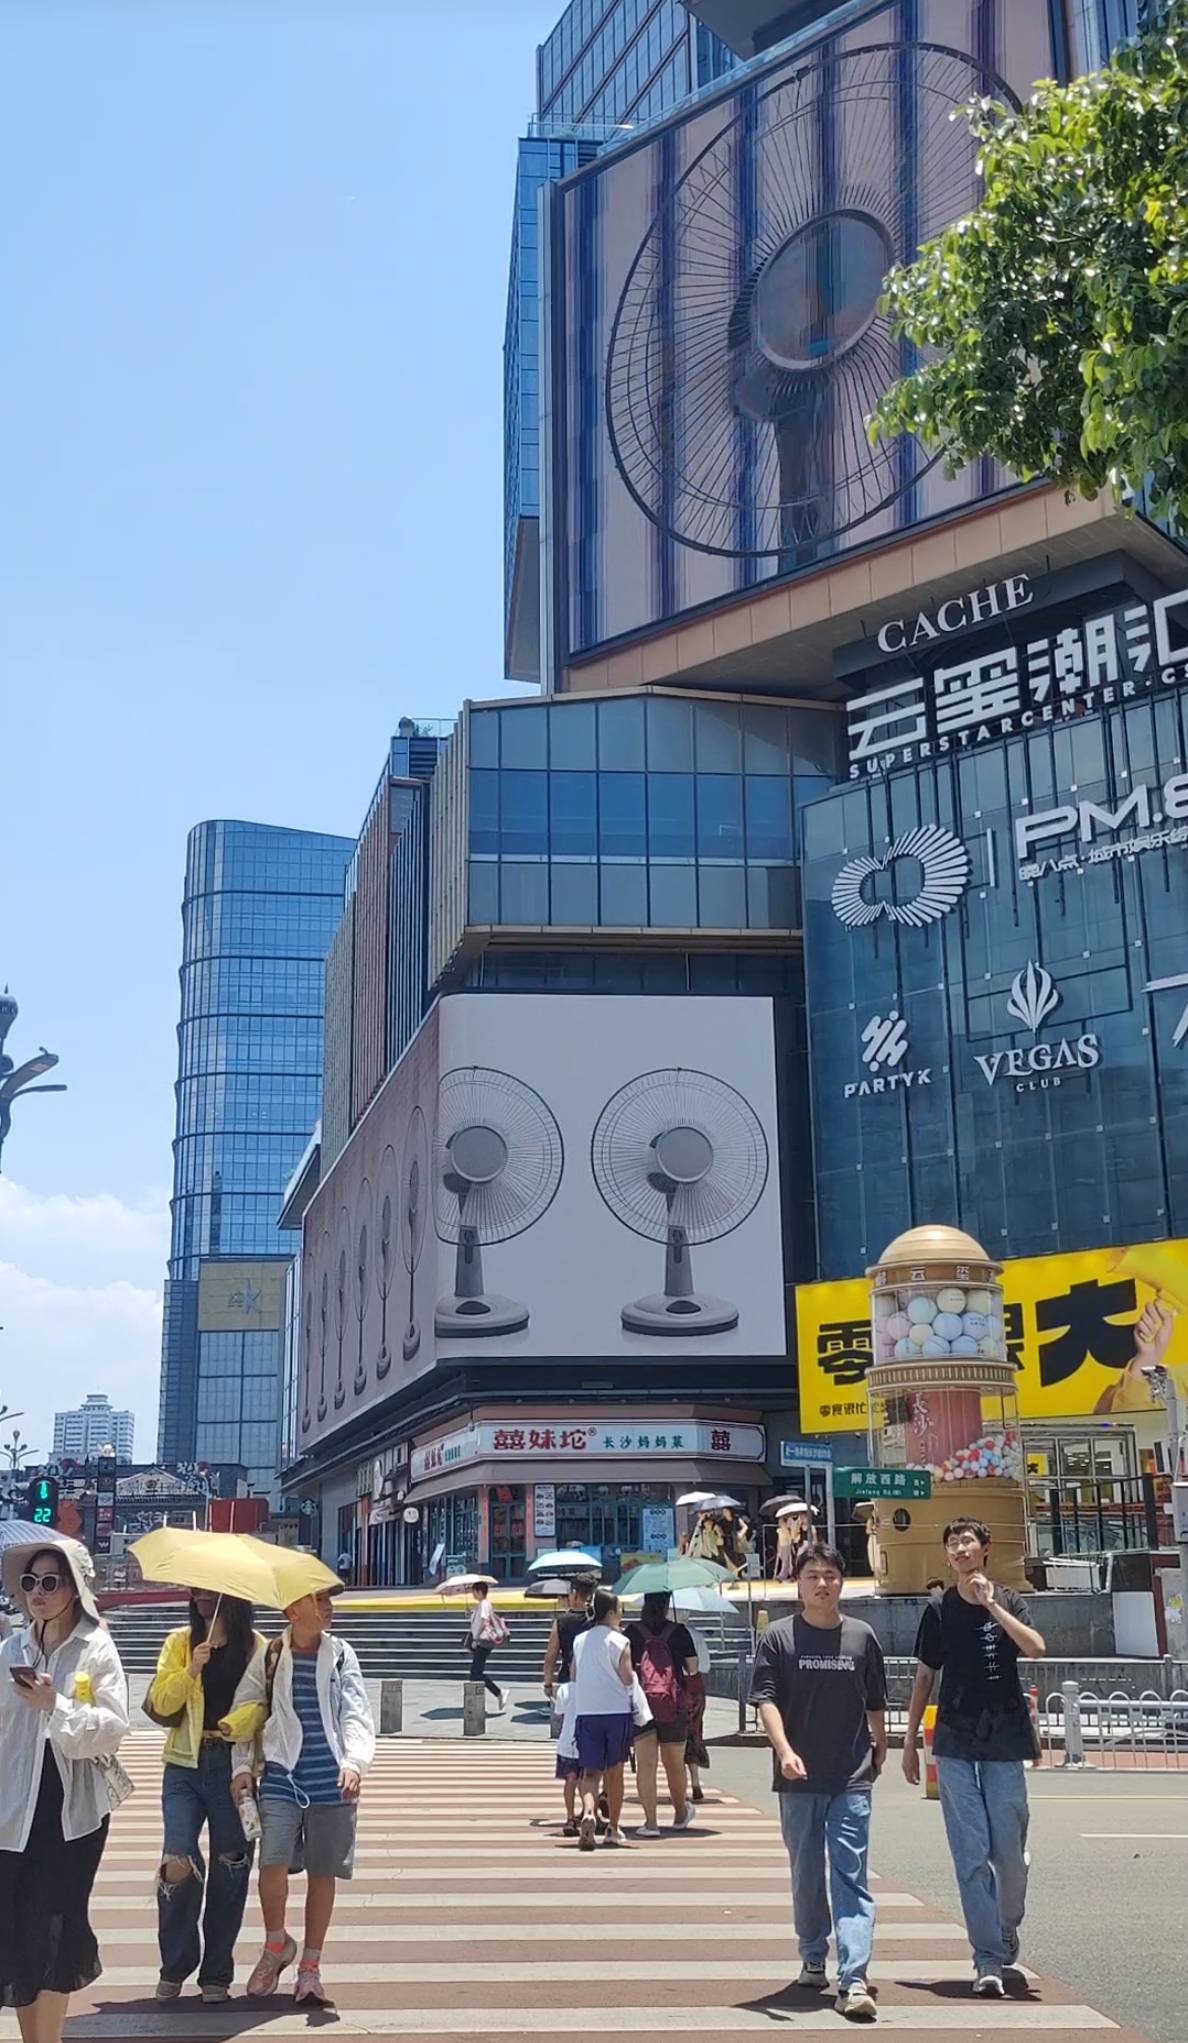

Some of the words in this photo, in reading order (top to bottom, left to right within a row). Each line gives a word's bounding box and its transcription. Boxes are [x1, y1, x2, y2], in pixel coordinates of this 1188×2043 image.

[877, 573, 1034, 653] CACHE
[973, 1033, 1100, 1087] VEGAS
[1015, 1077, 1062, 1093] CLUB
[602, 1435, 684, 1449] 长沙妈妈菜
[850, 1472, 906, 1486] 解放西路
[34, 1507, 52, 1523] 22
